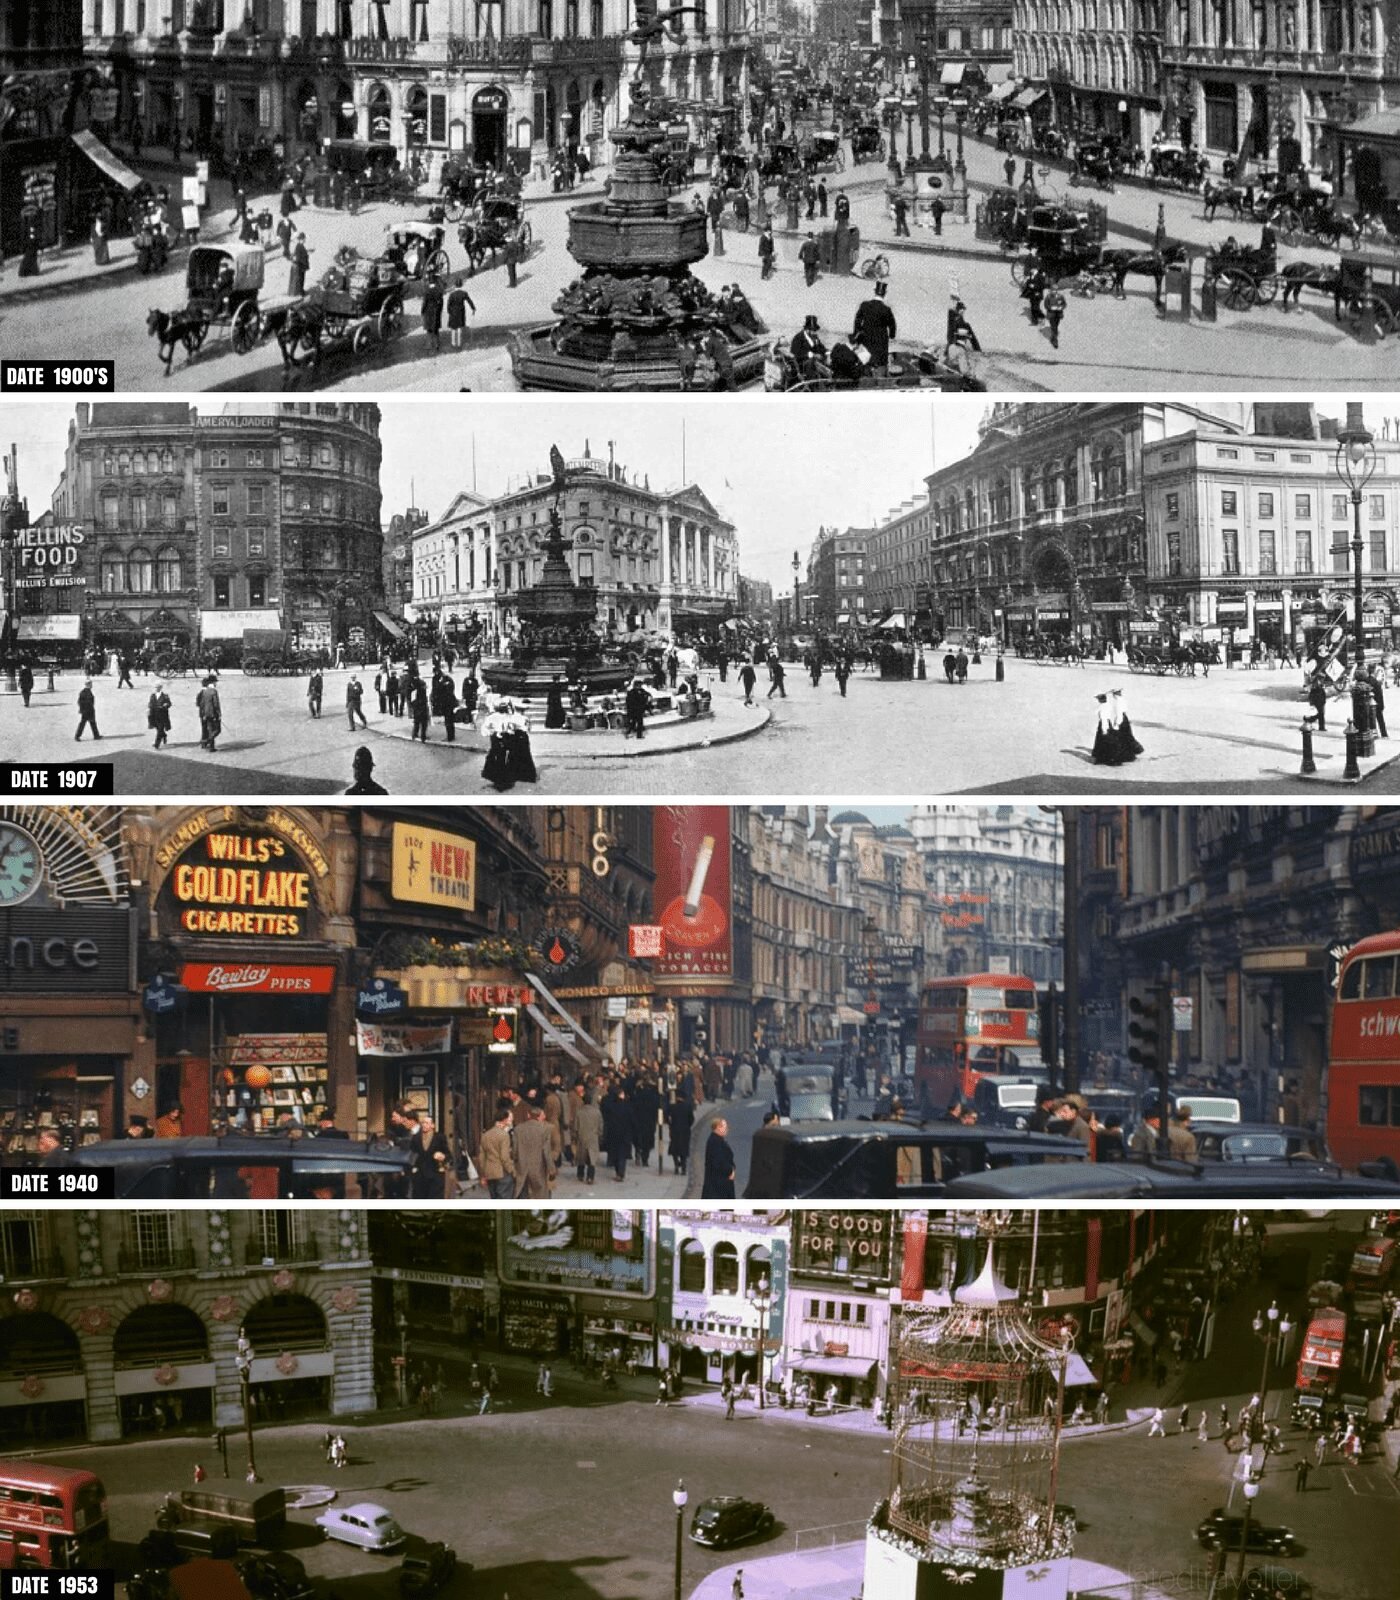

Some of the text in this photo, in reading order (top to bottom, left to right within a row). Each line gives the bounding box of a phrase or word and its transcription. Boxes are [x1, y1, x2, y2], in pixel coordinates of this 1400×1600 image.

[22, 546, 77, 567] FOOD
[431, 841, 471, 881] NEWS
[181, 909, 299, 936] CIGARETTES
[206, 964, 312, 991] Bewlay PIPES
[554, 985, 609, 998] MONICO
[801, 1211, 882, 1233] IS GOOD
[801, 1235, 882, 1257] FOR YOU
[720, 1340, 765, 1351] MONIC
